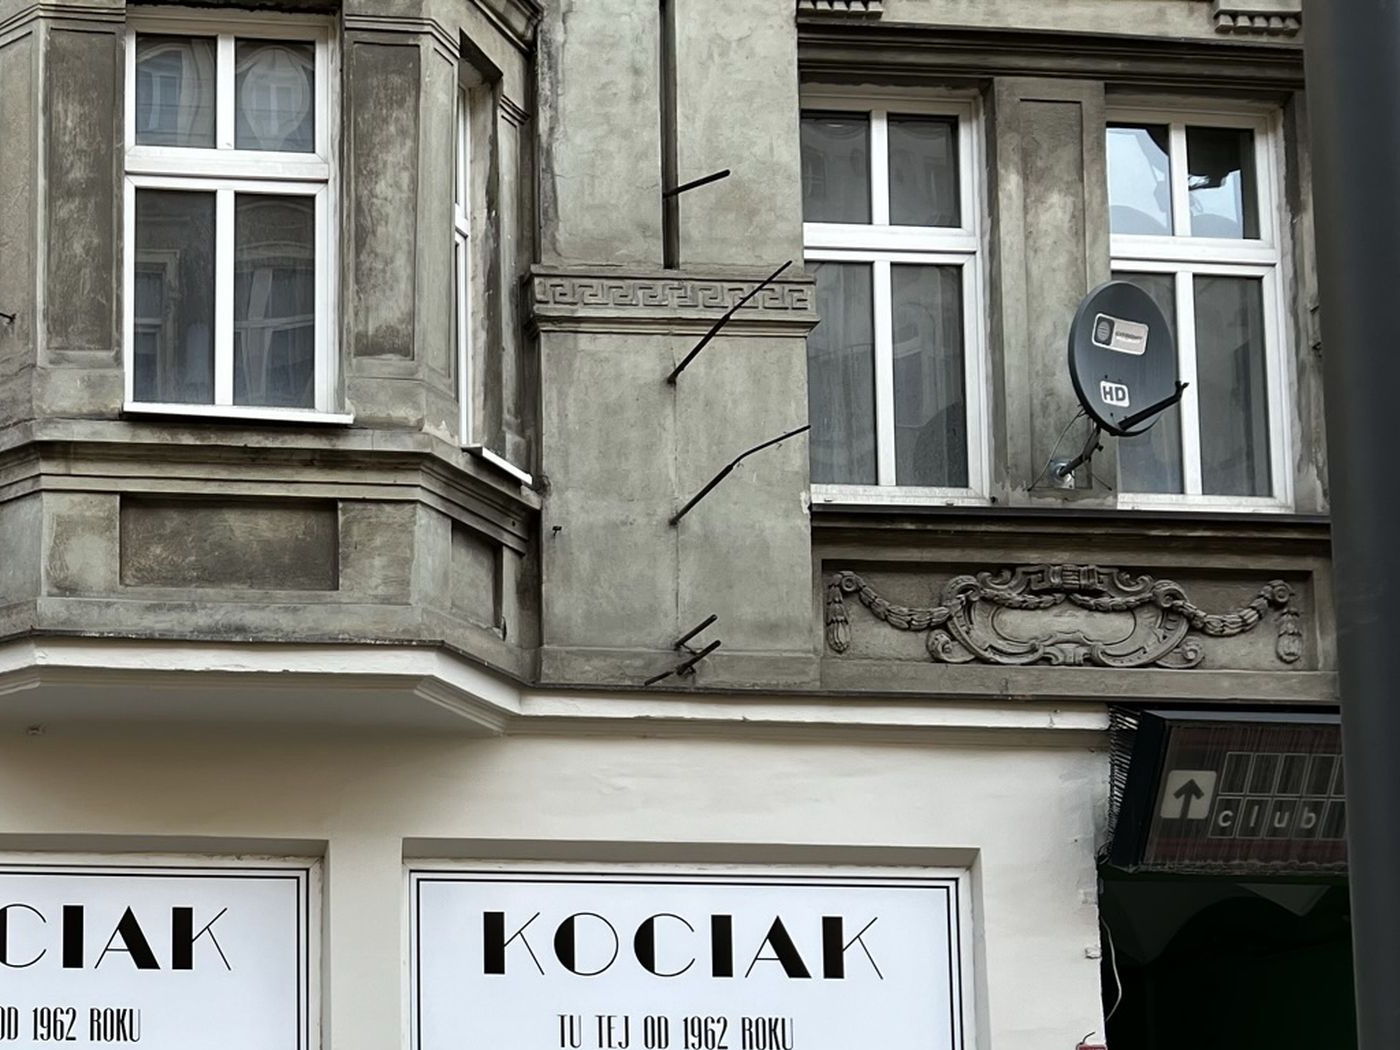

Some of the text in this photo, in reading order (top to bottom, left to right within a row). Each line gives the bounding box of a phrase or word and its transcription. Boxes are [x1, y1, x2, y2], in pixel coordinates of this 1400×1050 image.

[1102, 385, 1126, 401] HD
[1216, 804, 1317, 830] club
[483, 911, 884, 980] KOCIAK
[32, 1007, 77, 1042] 1962
[89, 1008, 141, 1043] ROKU
[557, 1014, 582, 1049] TU
[595, 1014, 630, 1050] TEJ
[643, 1015, 670, 1050] OD
[682, 1016, 729, 1050] 1962
